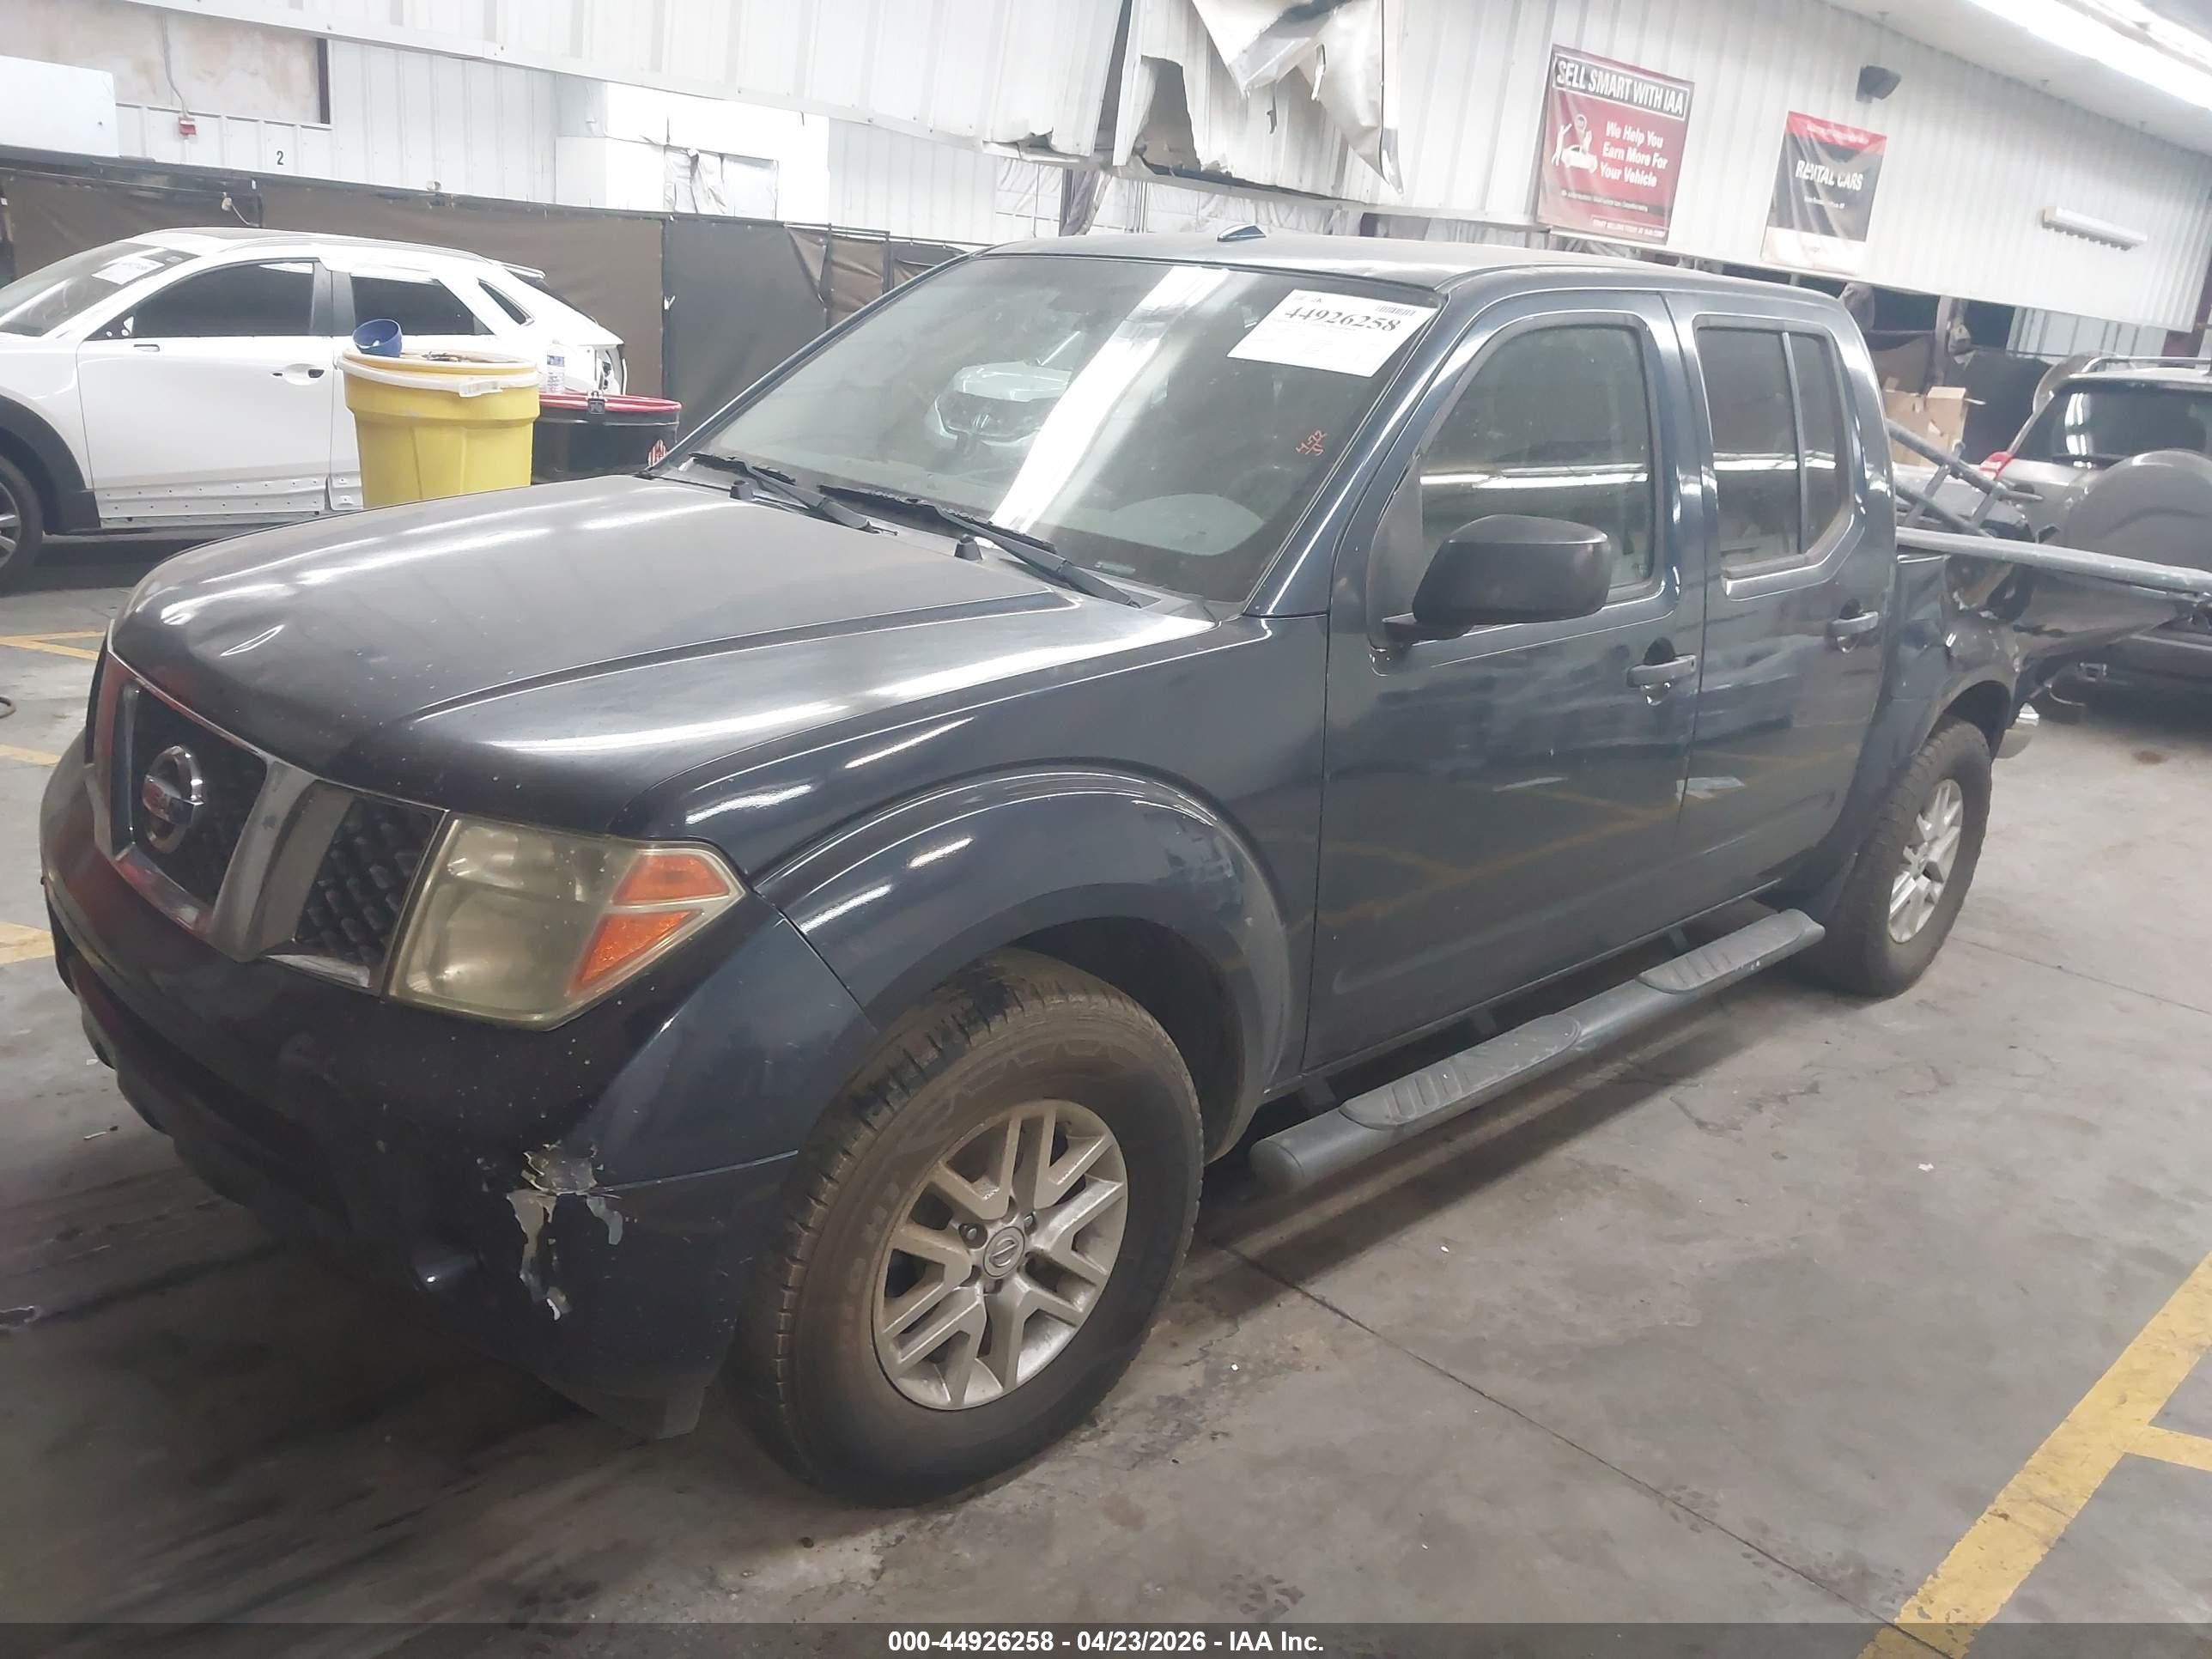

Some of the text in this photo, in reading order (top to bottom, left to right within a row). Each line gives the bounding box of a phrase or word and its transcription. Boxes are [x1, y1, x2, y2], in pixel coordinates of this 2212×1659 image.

[1556, 60, 1684, 114] SELL SMART WITH IAA
[1606, 120, 1663, 148] We Help You
[276, 150, 284, 165] 2
[1602, 141, 1668, 169] Earn More For
[1600, 161, 1657, 188] Your Vehicle
[1796, 159, 1863, 191] RENTAL CARS
[1285, 307, 1401, 332] 44926258
